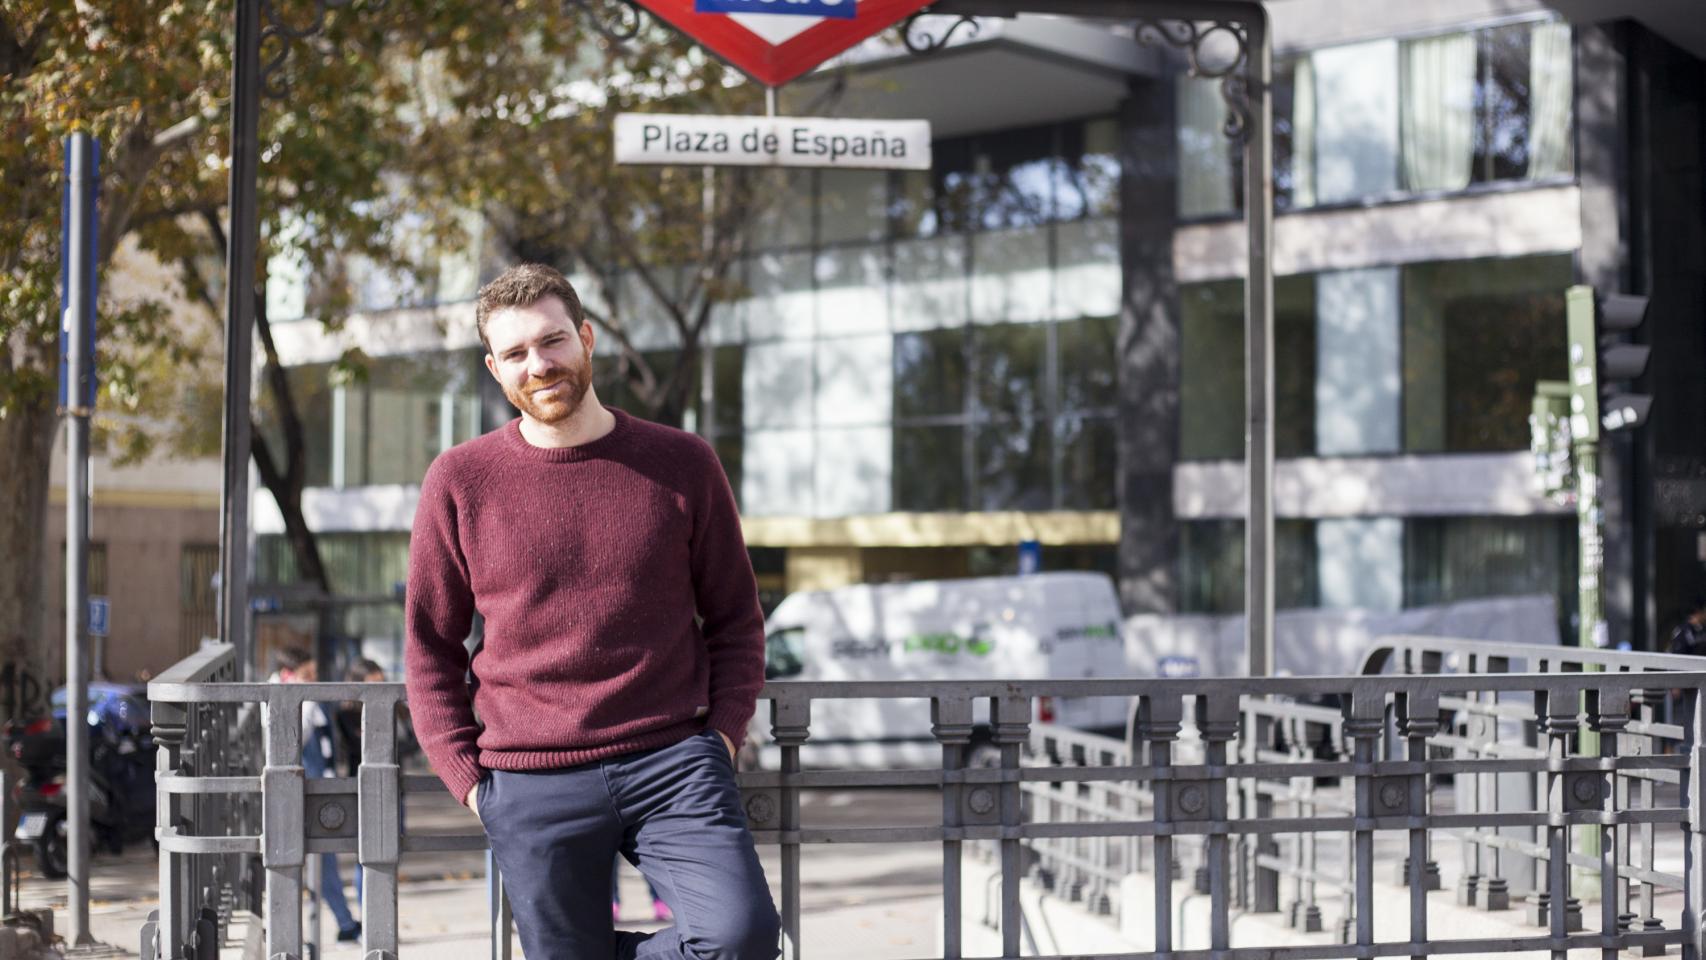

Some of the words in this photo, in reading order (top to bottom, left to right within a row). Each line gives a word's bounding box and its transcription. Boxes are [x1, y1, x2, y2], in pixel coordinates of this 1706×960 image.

[642, 124, 729, 153] Plaza
[741, 127, 780, 154] de
[791, 128, 907, 160] España
